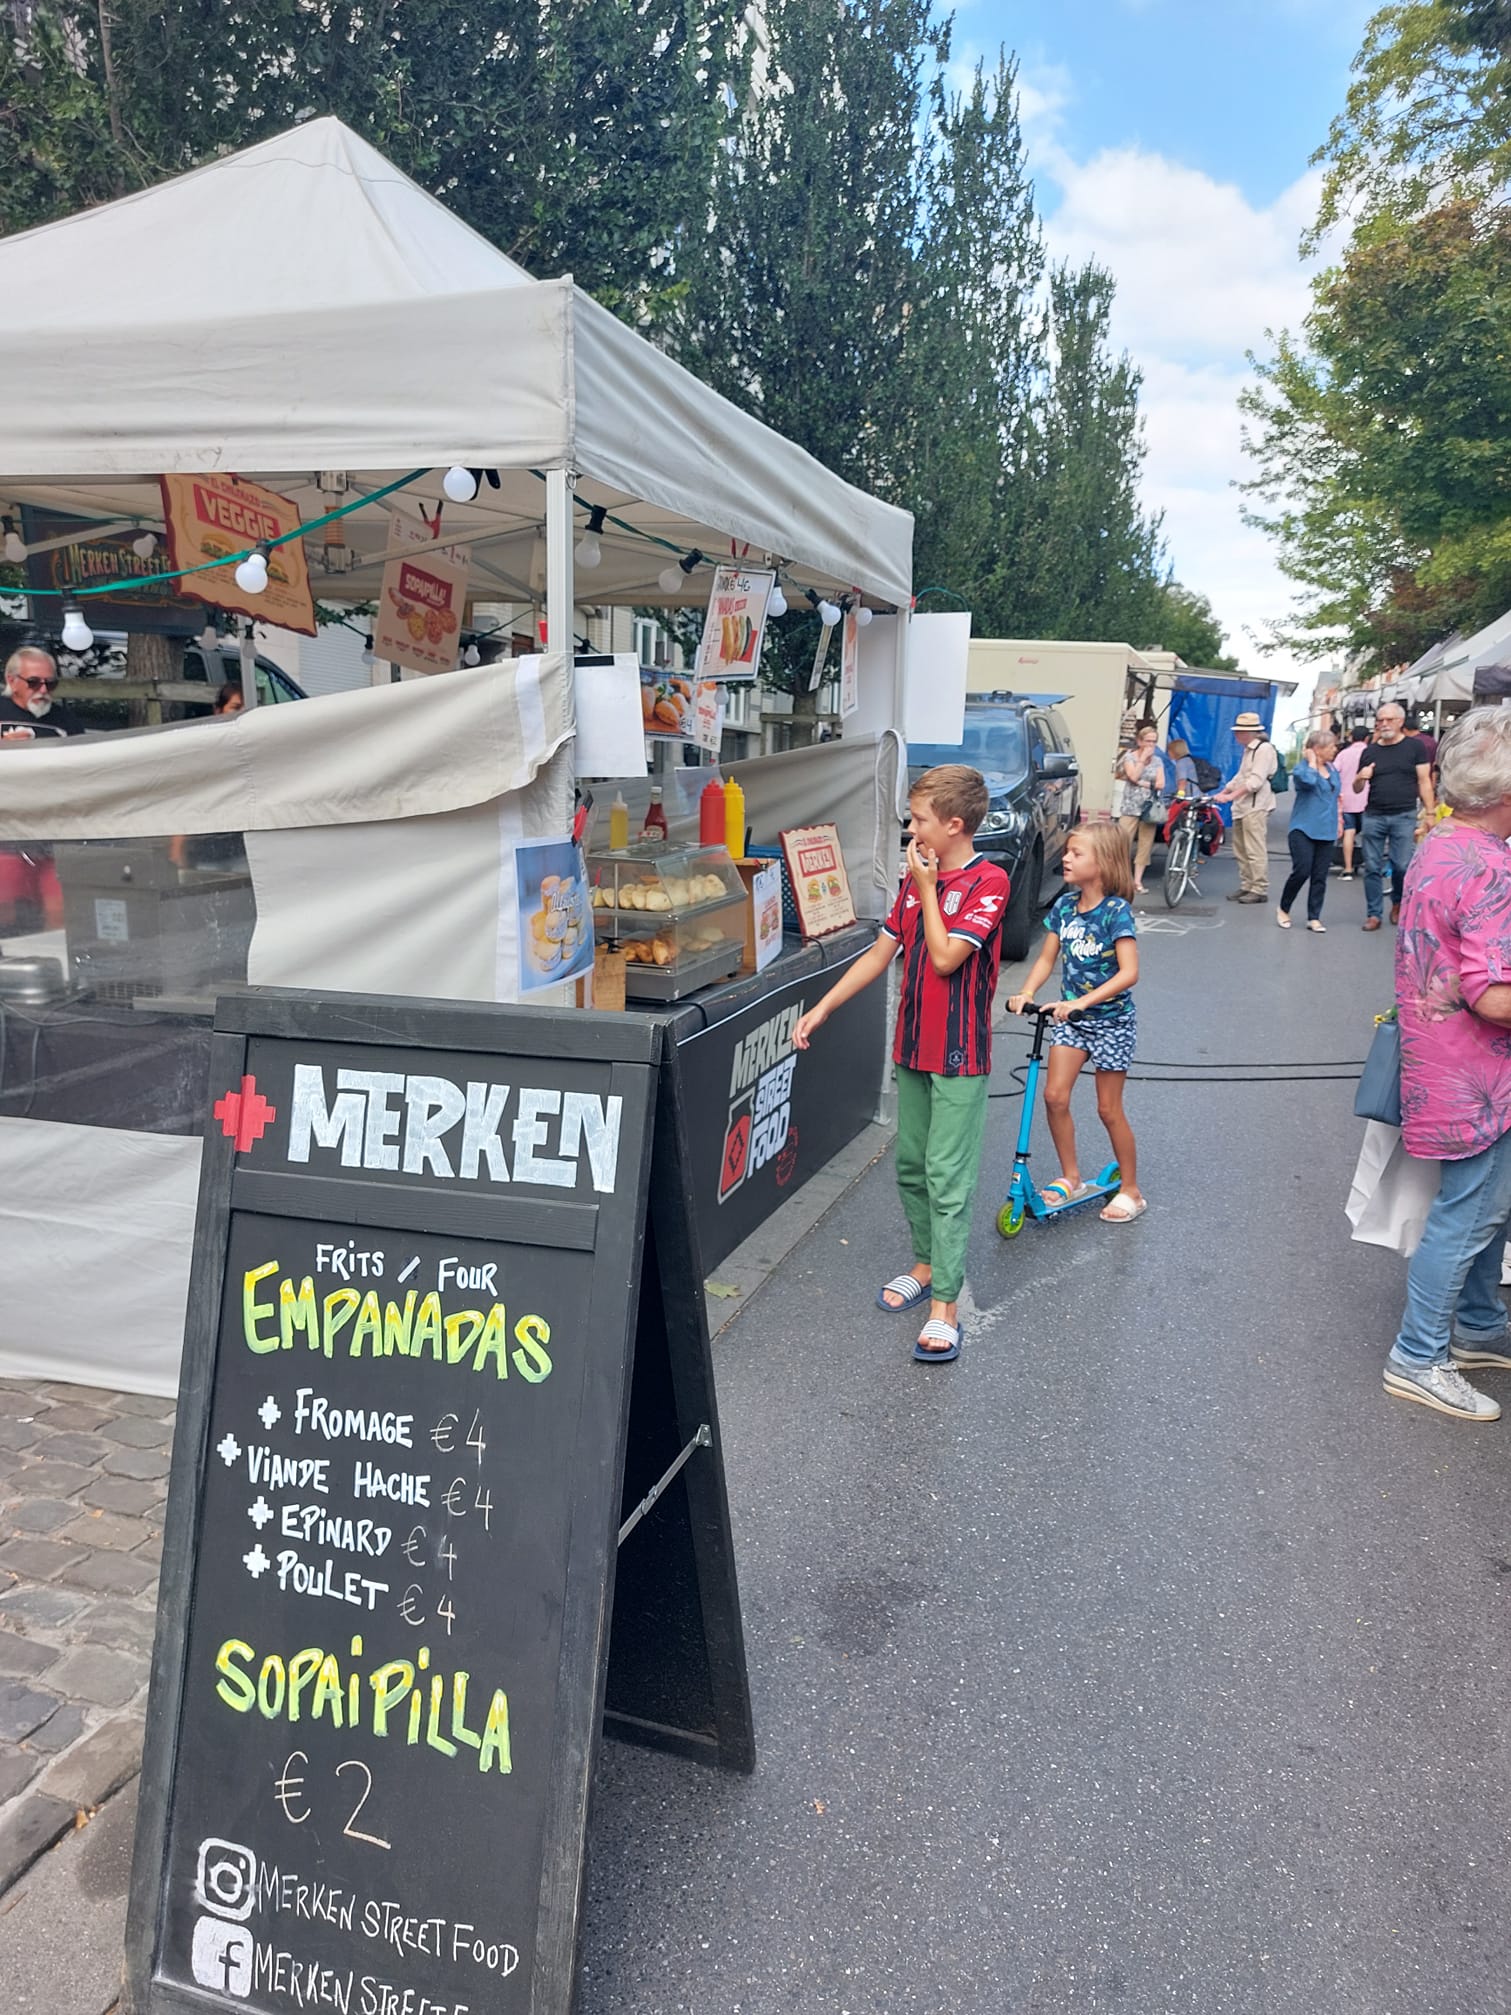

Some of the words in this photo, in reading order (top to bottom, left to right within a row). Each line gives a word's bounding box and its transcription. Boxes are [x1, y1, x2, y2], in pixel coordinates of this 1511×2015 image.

[200, 488, 276, 541] VEGGIE
[1070, 938, 1103, 961] Rider
[729, 1000, 804, 1098] MERKEN
[754, 1053, 797, 1124] STREET
[287, 1063, 623, 1193] MERKEN
[747, 1101, 790, 1178] FOOD
[437, 1257, 498, 1297] FOUR
[243, 1260, 553, 1383] EMPANADAS
[294, 1388, 414, 1448] FROMAGE
[354, 1461, 431, 1507] HACHE
[276, 1550, 389, 1610] POULET
[257, 1861, 356, 1931] MERKEN
[360, 1900, 446, 1957] STREET
[453, 1924, 519, 1977] FOOD
[254, 1943, 353, 2015] MERKEN
